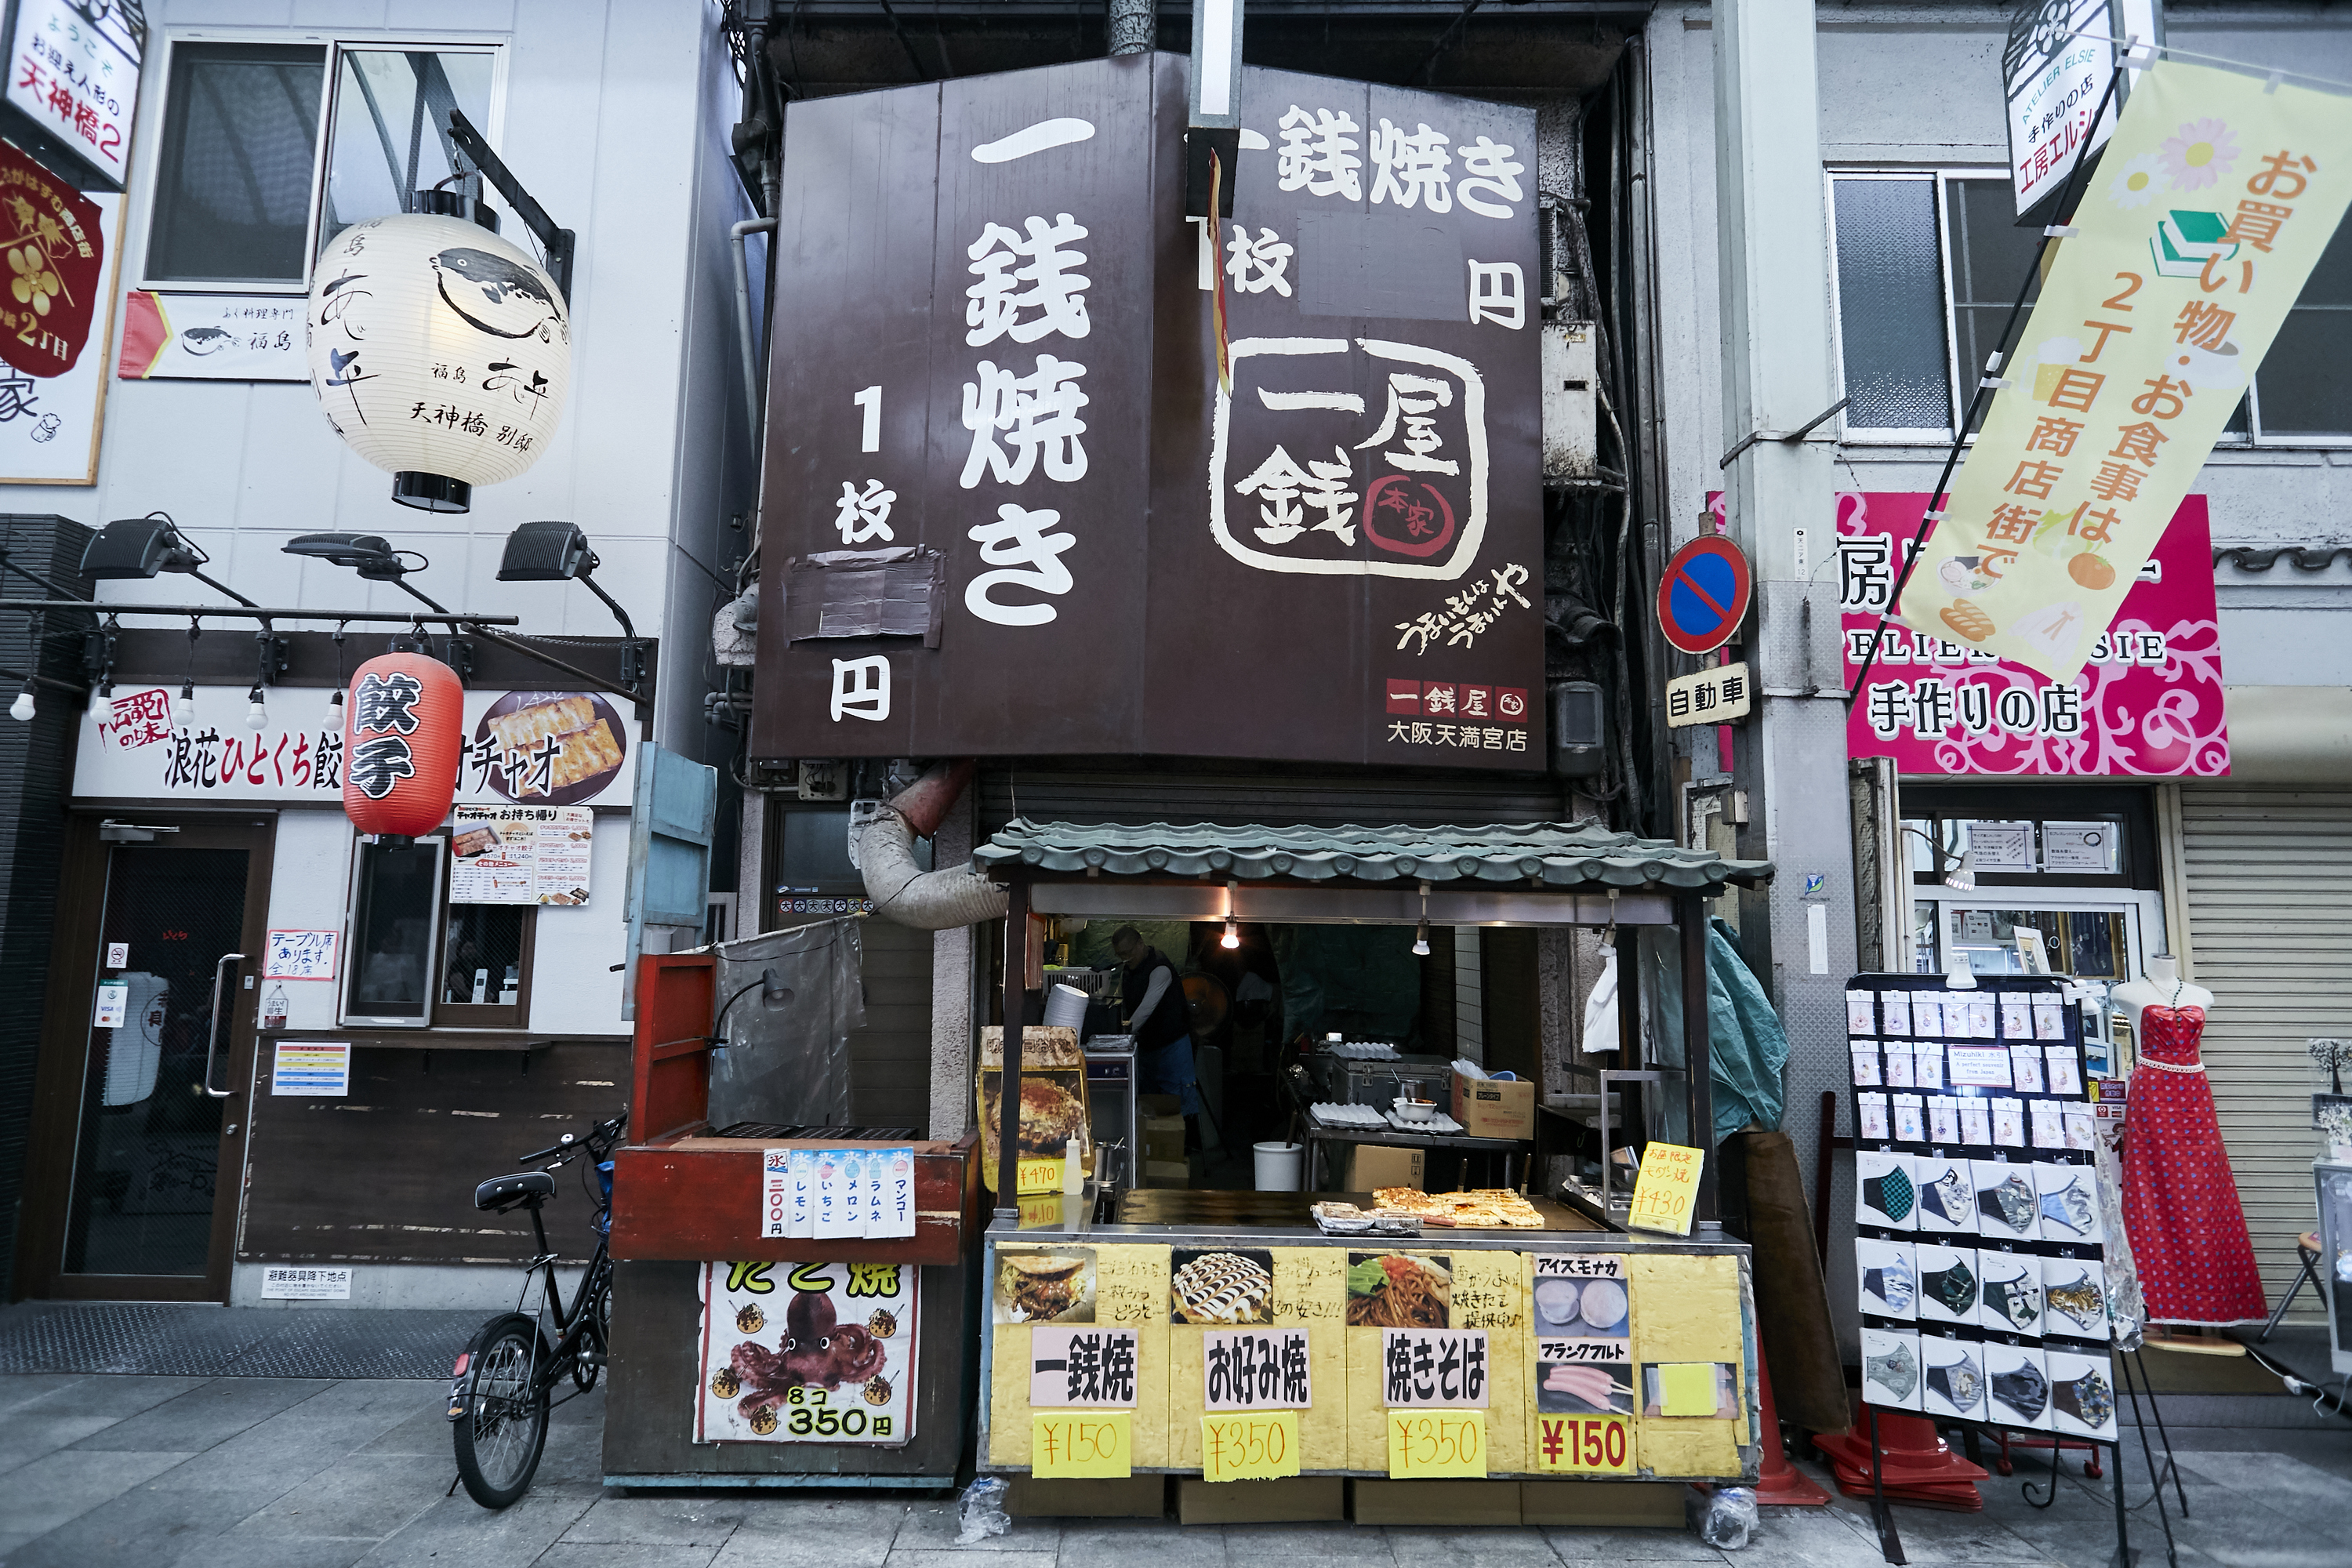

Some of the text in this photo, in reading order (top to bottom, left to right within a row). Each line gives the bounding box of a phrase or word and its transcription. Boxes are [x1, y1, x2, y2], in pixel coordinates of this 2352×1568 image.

[48, 13, 113, 78] ようこそ
[18, 53, 121, 164] 天神橋2
[2022, 49, 2096, 125] ATELIER ELSIE
[2028, 73, 2093, 143] 手作りの店
[2020, 103, 2107, 194] 工房エルシ
[1468, 259, 1525, 330] 円
[248, 330, 292, 350] 福島
[2067, 151, 2318, 544] お買い物・お食事は
[431, 363, 466, 383] 福島
[960, 118, 1095, 626] 一銭焼き
[410, 401, 534, 454] 天神橋 別邸
[1976, 272, 2143, 579] 2丁目商店街で
[1377, 488, 1434, 536] 本家
[830, 655, 891, 722] 円
[1670, 677, 1744, 717] 自動車
[1871, 682, 2078, 734] 手作りの店
[349, 672, 423, 800] 餃子
[1387, 720, 1528, 753] 大阪天満宮店
[499, 809, 557, 821] お持ち帰り
[272, 932, 334, 950] テーブル席
[768, 1155, 786, 1167] 氷
[1019, 1167, 1054, 1186] ¥470
[822, 1181, 833, 1222] いちご
[848, 1180, 858, 1221] メロン
[870, 1181, 881, 1221] ラムネ
[895, 1179, 906, 1221] マンゴー
[1636, 1186, 1685, 1214] ¥430
[267, 1270, 347, 1282] 避難器具降下地点
[1538, 1258, 1618, 1276] アイスモナカ
[1034, 1334, 1134, 1402] 一銭焼
[1208, 1335, 1308, 1404] お好み焼
[1386, 1333, 1485, 1402] 焼きそば
[1541, 1342, 1624, 1359] フランクフルト
[789, 1388, 827, 1406] 8コ
[789, 1408, 891, 1436] 350円
[1044, 1422, 1116, 1465] ¥150
[1397, 1420, 1477, 1468] ¥350
[1541, 1420, 1626, 1467] ¥150
[1209, 1422, 1285, 1475] ¥350
